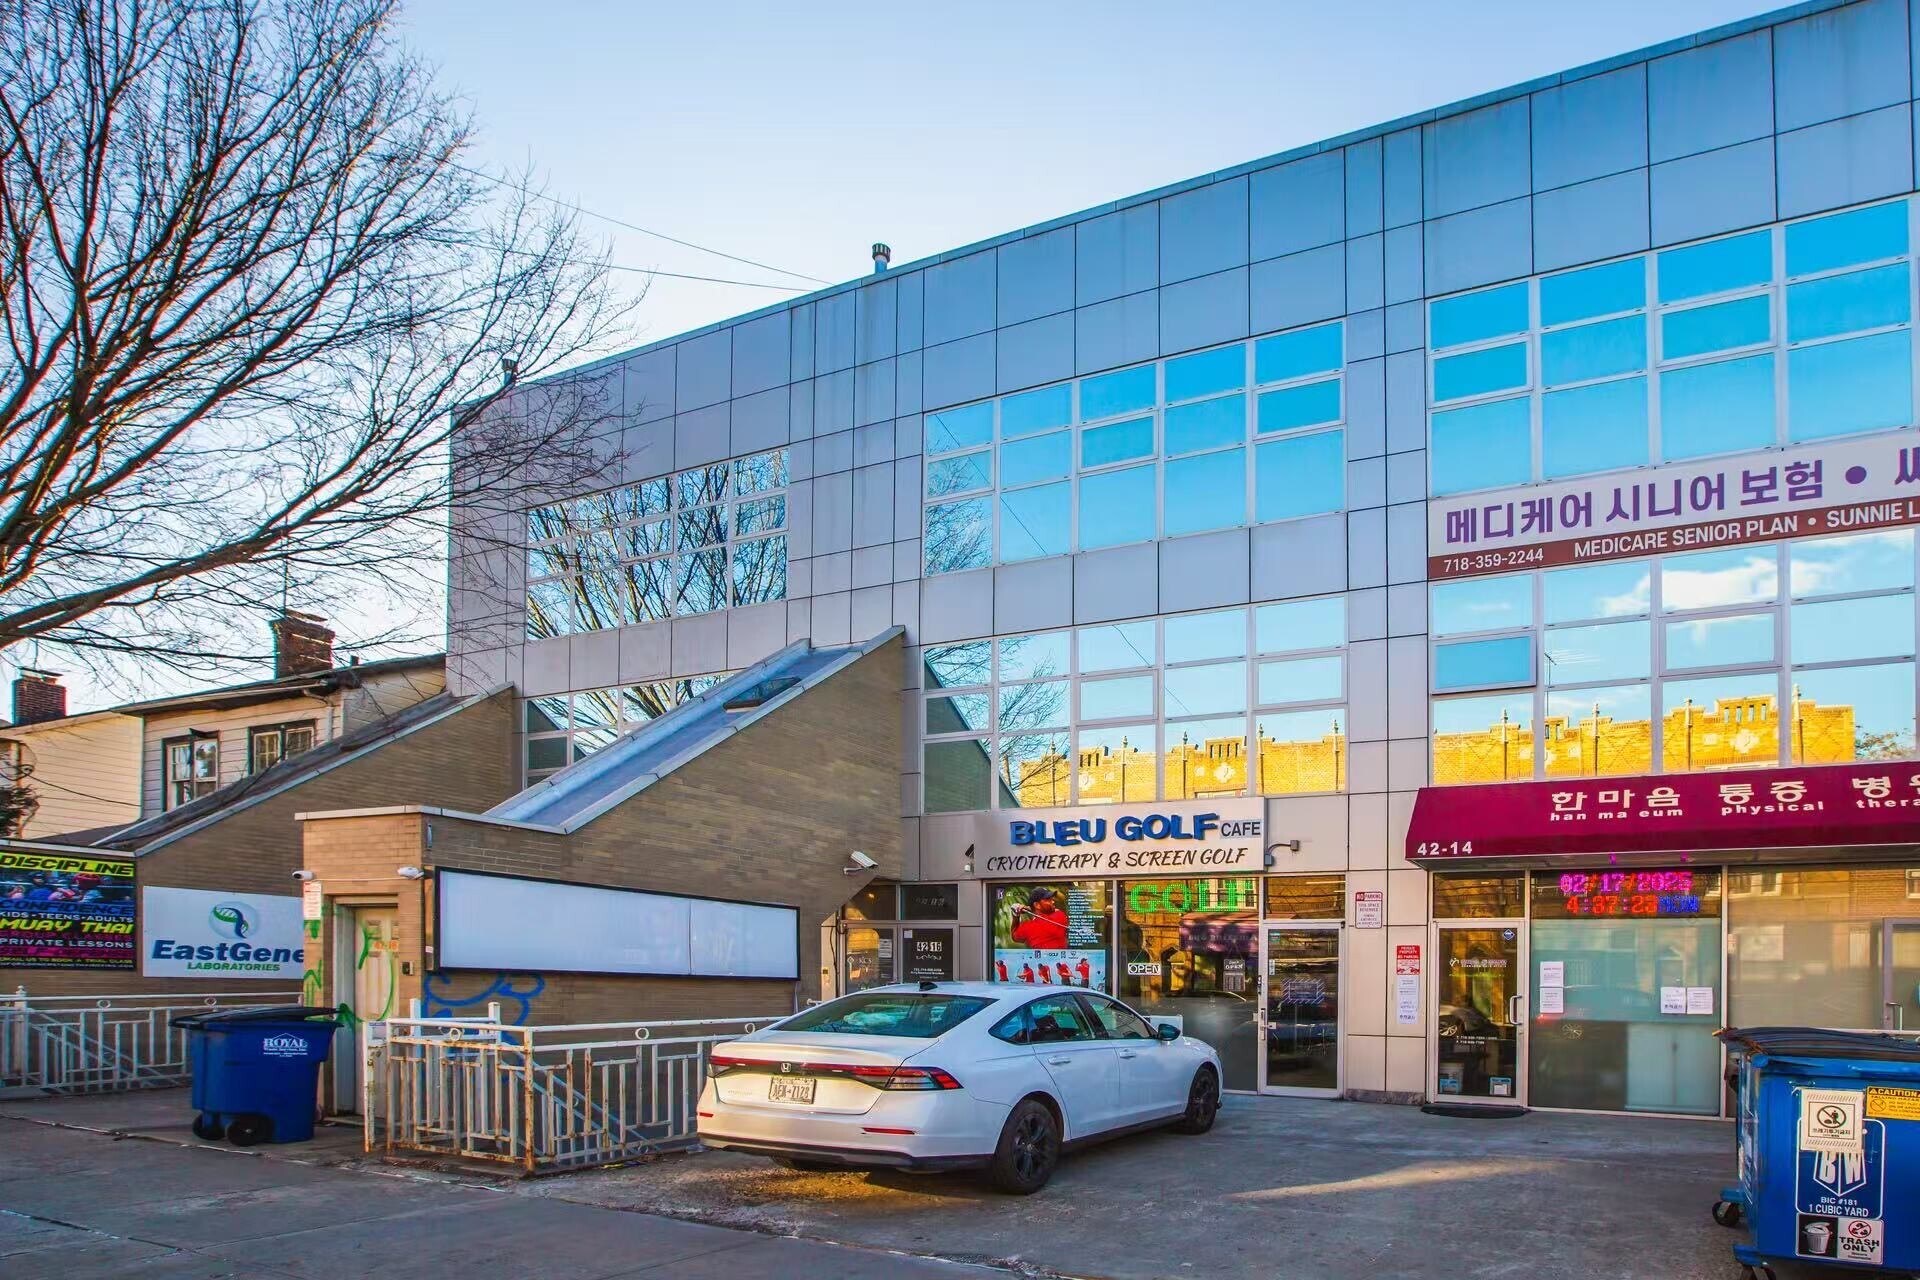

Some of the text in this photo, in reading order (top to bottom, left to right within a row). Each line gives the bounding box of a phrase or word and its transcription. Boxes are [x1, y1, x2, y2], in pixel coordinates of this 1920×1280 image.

[1446, 460, 1823, 544] 메디케어 시니어 보험
[1574, 531, 1668, 558] MEDICARE
[1672, 521, 1741, 546] SENIOR
[1746, 515, 1798, 537] PLAN
[1826, 502, 1903, 528] SUNNIE
[1444, 548, 1544, 573] 718-359-2244
[1551, 786, 1681, 811] 한마음
[1719, 780, 1807, 805] 통증
[1551, 812, 1586, 821] han
[1599, 811, 1627, 820] ma
[1639, 808, 1683, 818] eum
[1721, 801, 1824, 816] physical
[1010, 812, 1261, 847] BLEU GOLF CAFE
[1417, 841, 1473, 856] 42-14
[0, 854, 134, 875] DISCIPLINE
[987, 848, 1248, 871] CRYOTHERAPY & SCREEN GOLF
[1560, 871, 1692, 892] 02/17/2025
[0, 910, 133, 923] KIDS TEENS ADULTS
[0, 918, 134, 934] MUAY THAI
[0, 938, 133, 949] PRIVATE LESSONS
[187, 962, 281, 971] LABORATORIES
[1129, 964, 1159, 974] OPEN
[264, 1038, 308, 1048] ROYAL
[1878, 1089, 1917, 1097] CAUTION
[1815, 1204, 1842, 1214] CUBIC
[1844, 1206, 1869, 1217] YARD
[1839, 1236, 1880, 1247] TRASH
[1843, 1244, 1876, 1253] ONLY
